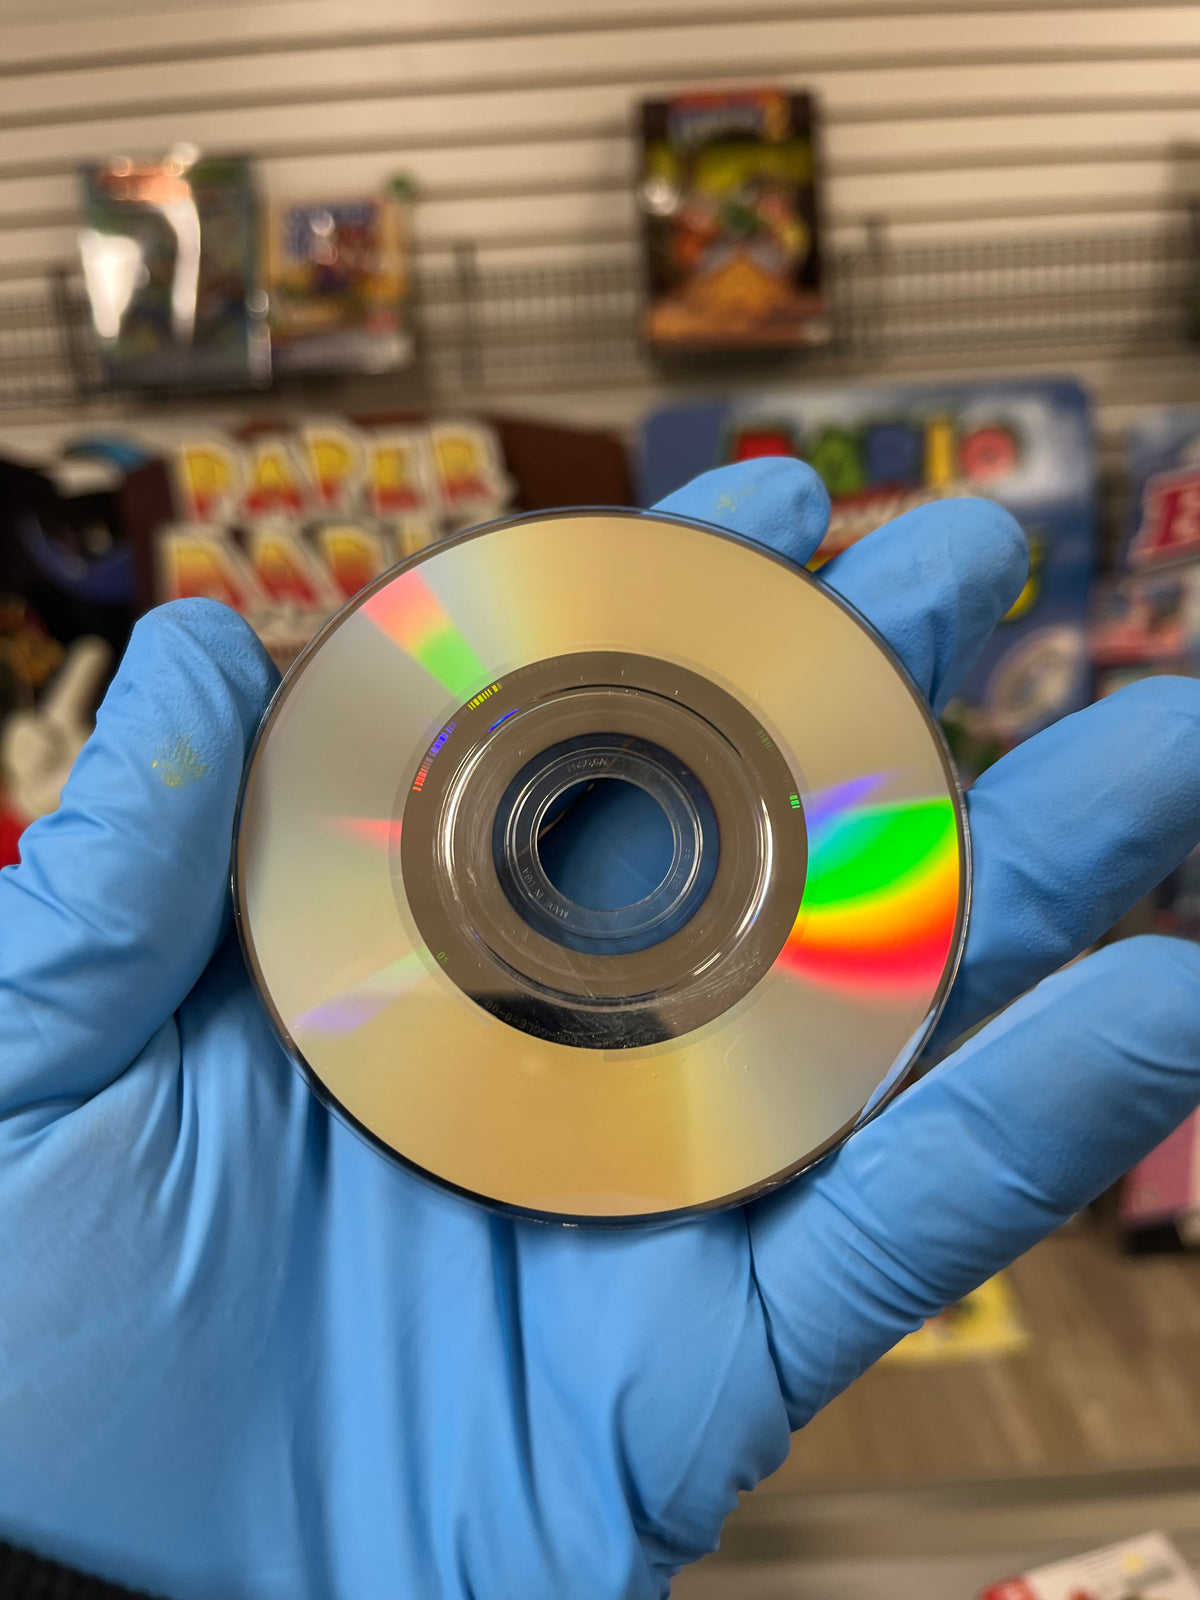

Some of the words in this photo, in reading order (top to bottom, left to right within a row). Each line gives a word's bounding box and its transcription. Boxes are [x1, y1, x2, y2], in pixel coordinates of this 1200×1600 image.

[182, 432, 496, 524] PAPER
[170, 524, 434, 614] MAR
[543, 898, 569, 920] MADE
